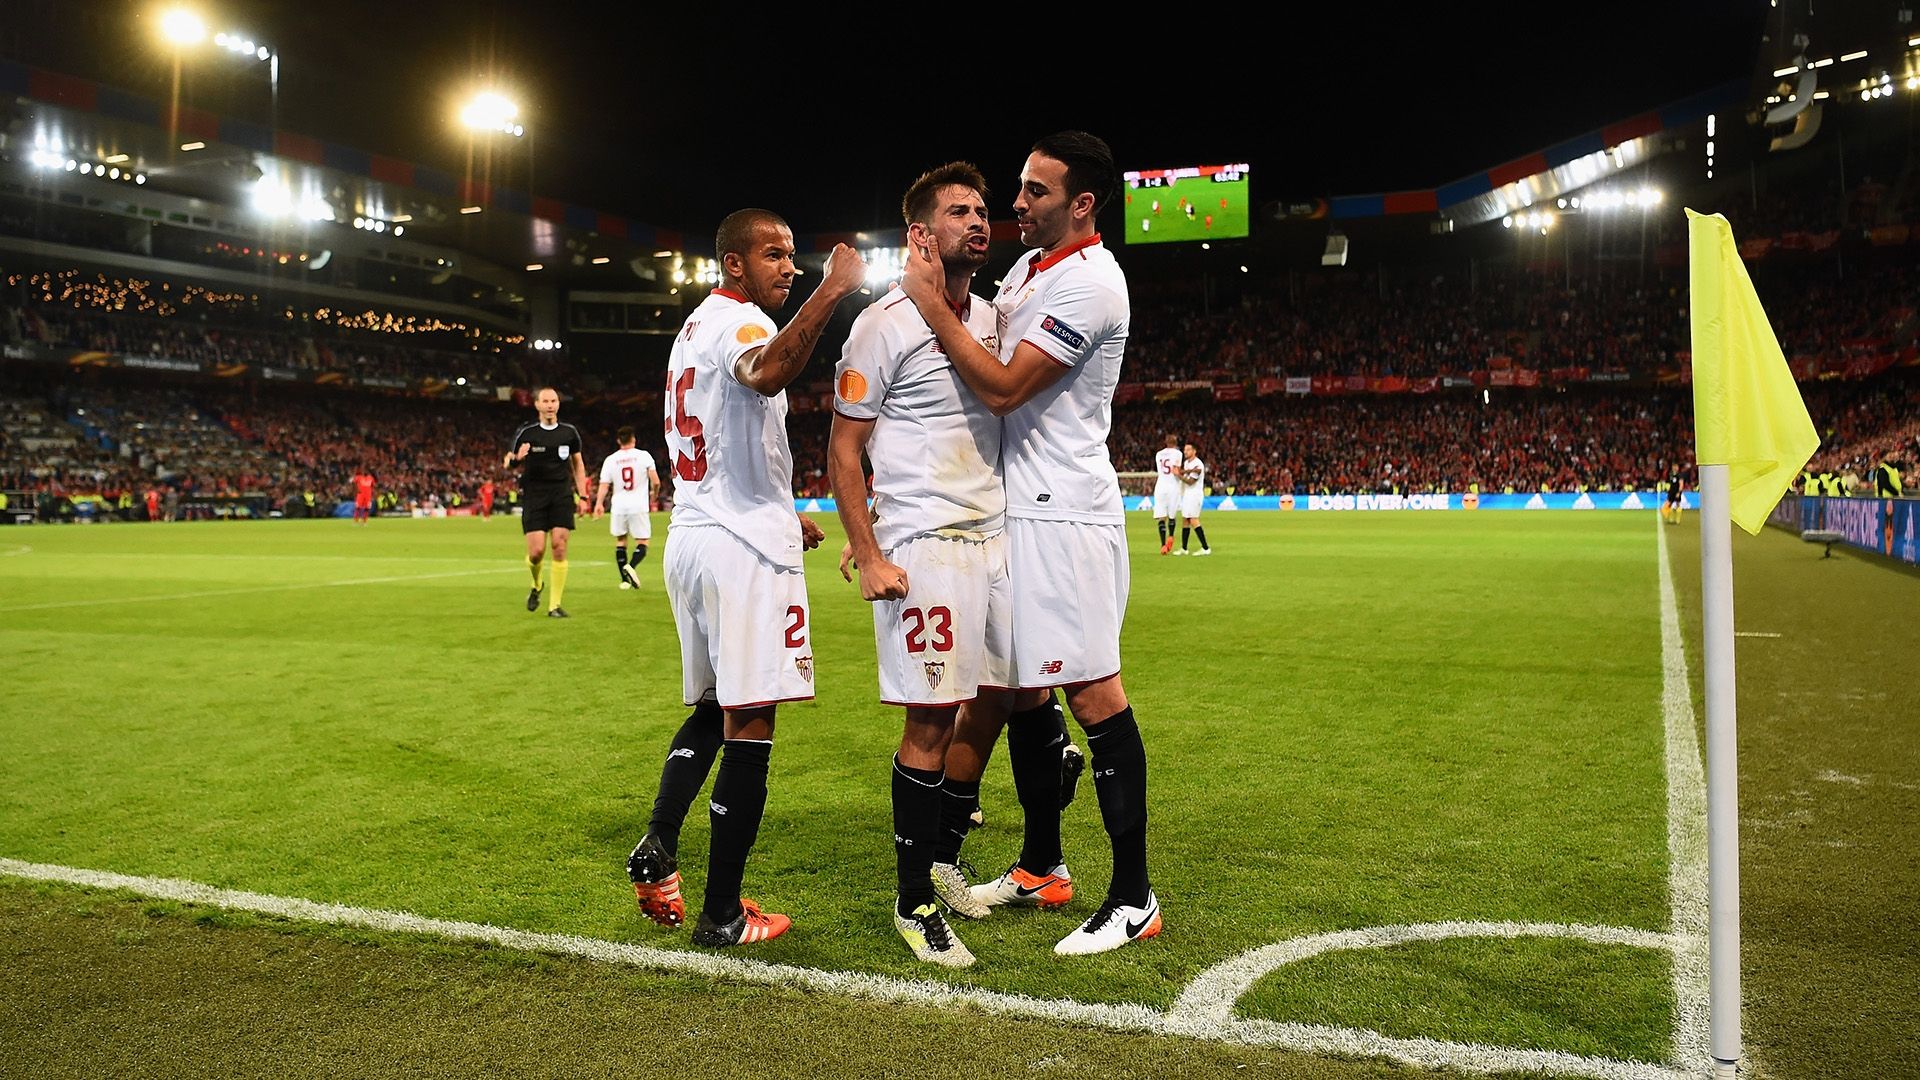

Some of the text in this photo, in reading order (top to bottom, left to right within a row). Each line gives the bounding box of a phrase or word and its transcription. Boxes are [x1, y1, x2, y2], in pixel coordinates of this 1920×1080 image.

[1052, 324, 1082, 346] RESPECT
[1159, 458, 1172, 475] 15
[621, 466, 634, 491] 9
[1308, 494, 1355, 510] BOSS
[901, 605, 954, 653] 23
